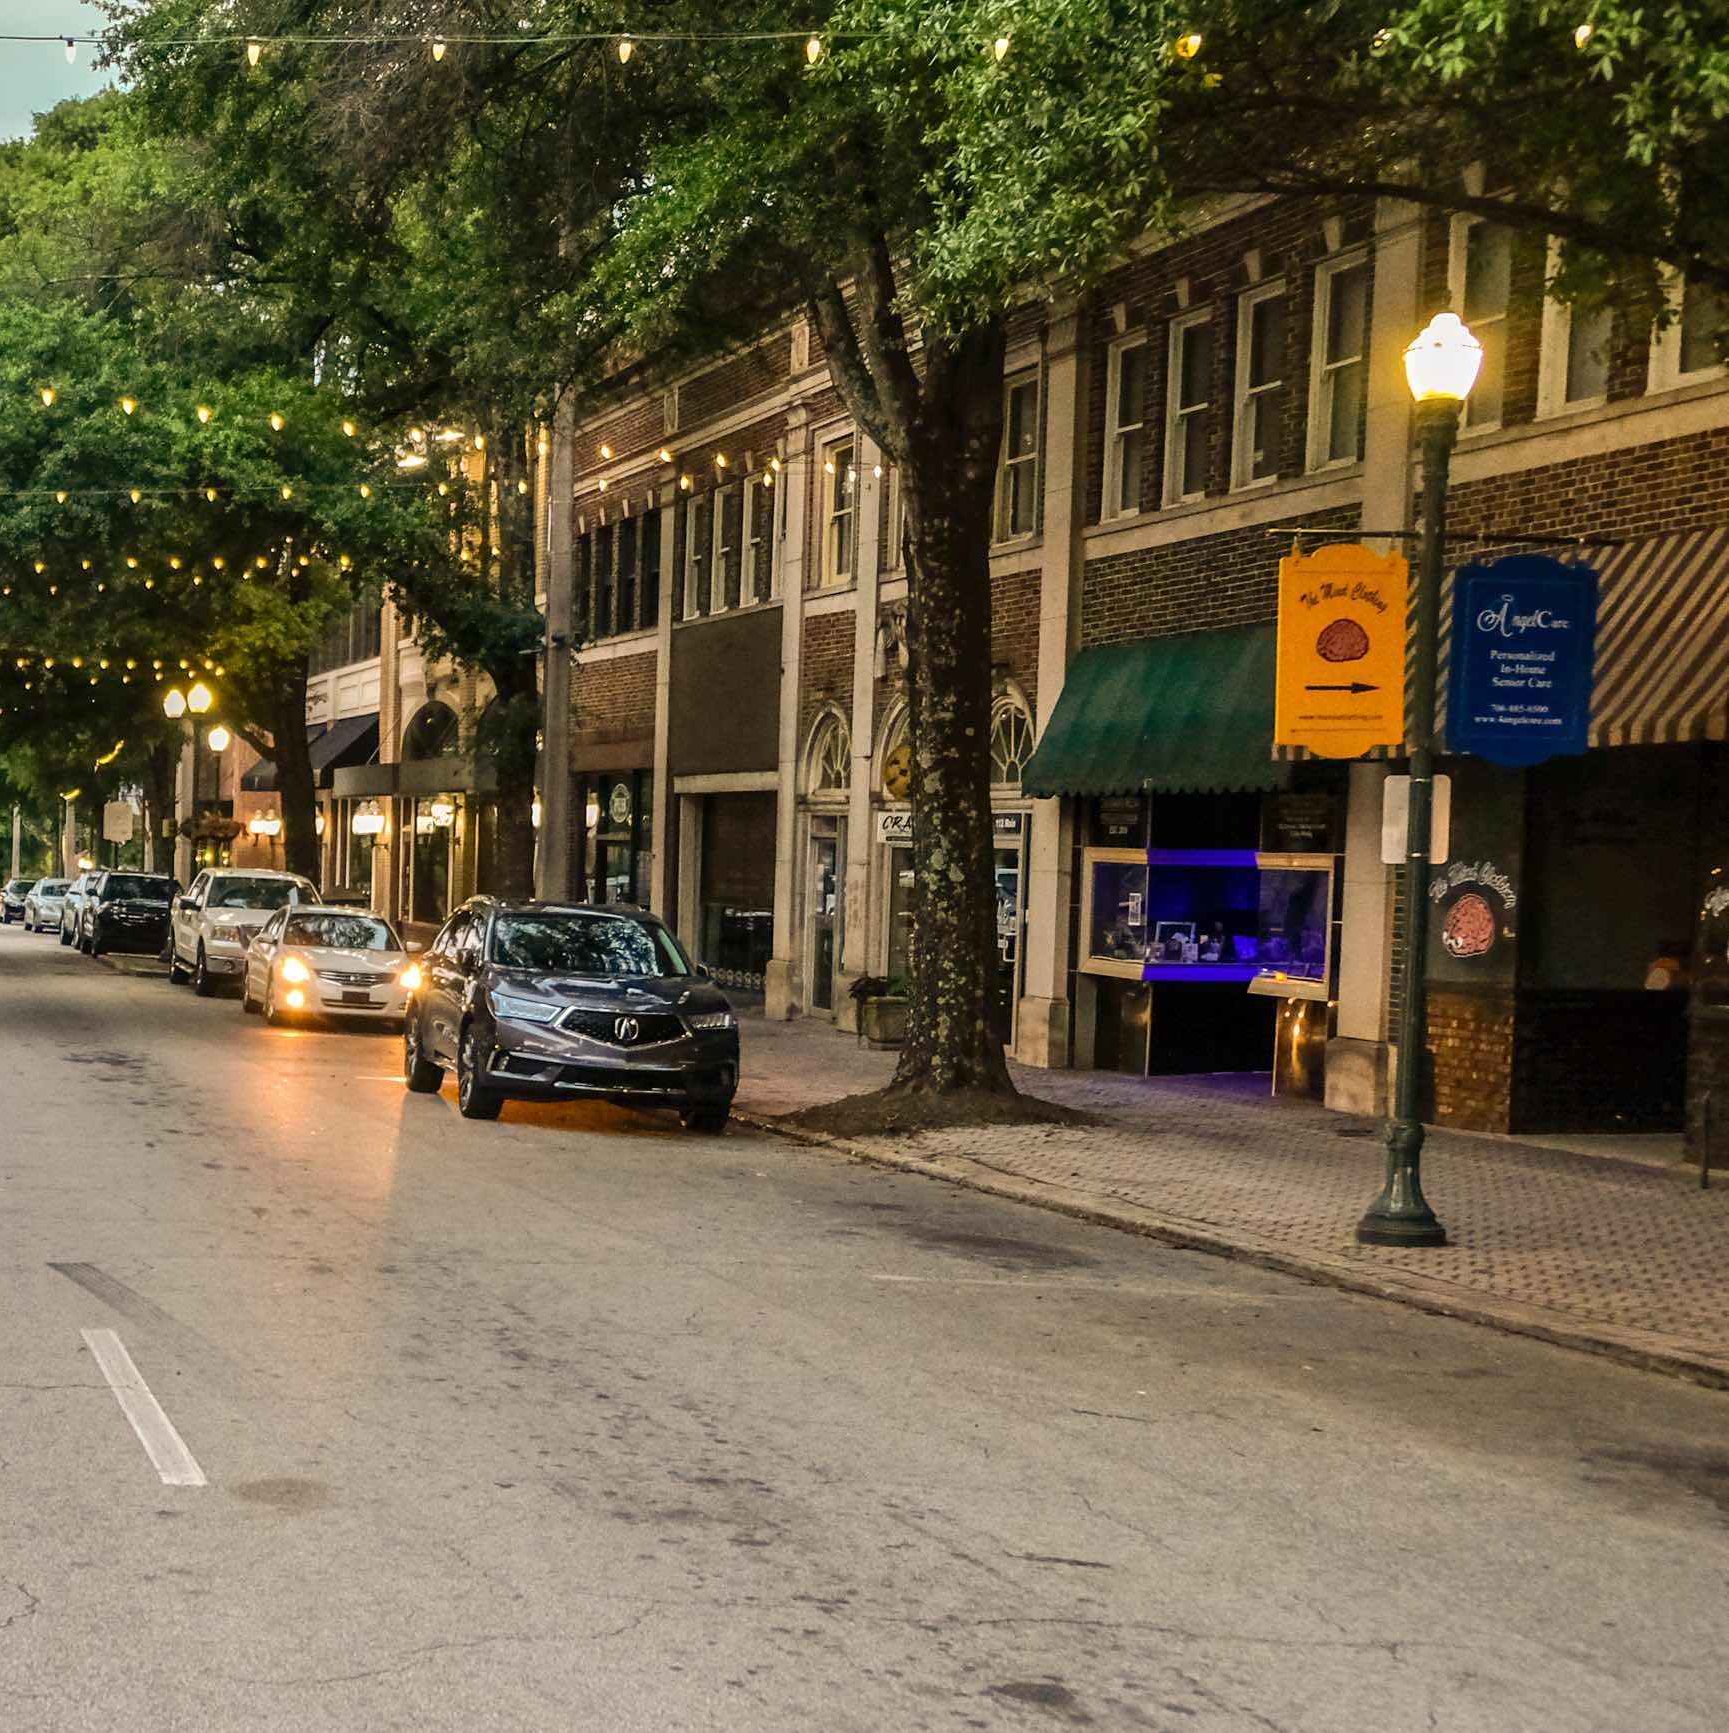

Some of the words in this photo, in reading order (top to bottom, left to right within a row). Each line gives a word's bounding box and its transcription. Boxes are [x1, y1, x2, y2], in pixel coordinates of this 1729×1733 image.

[1490, 649, 1556, 662] Personalized
[1500, 663, 1547, 675] In-Home
[1492, 676, 1525, 688] Senior
[1527, 677, 1553, 689] Care
